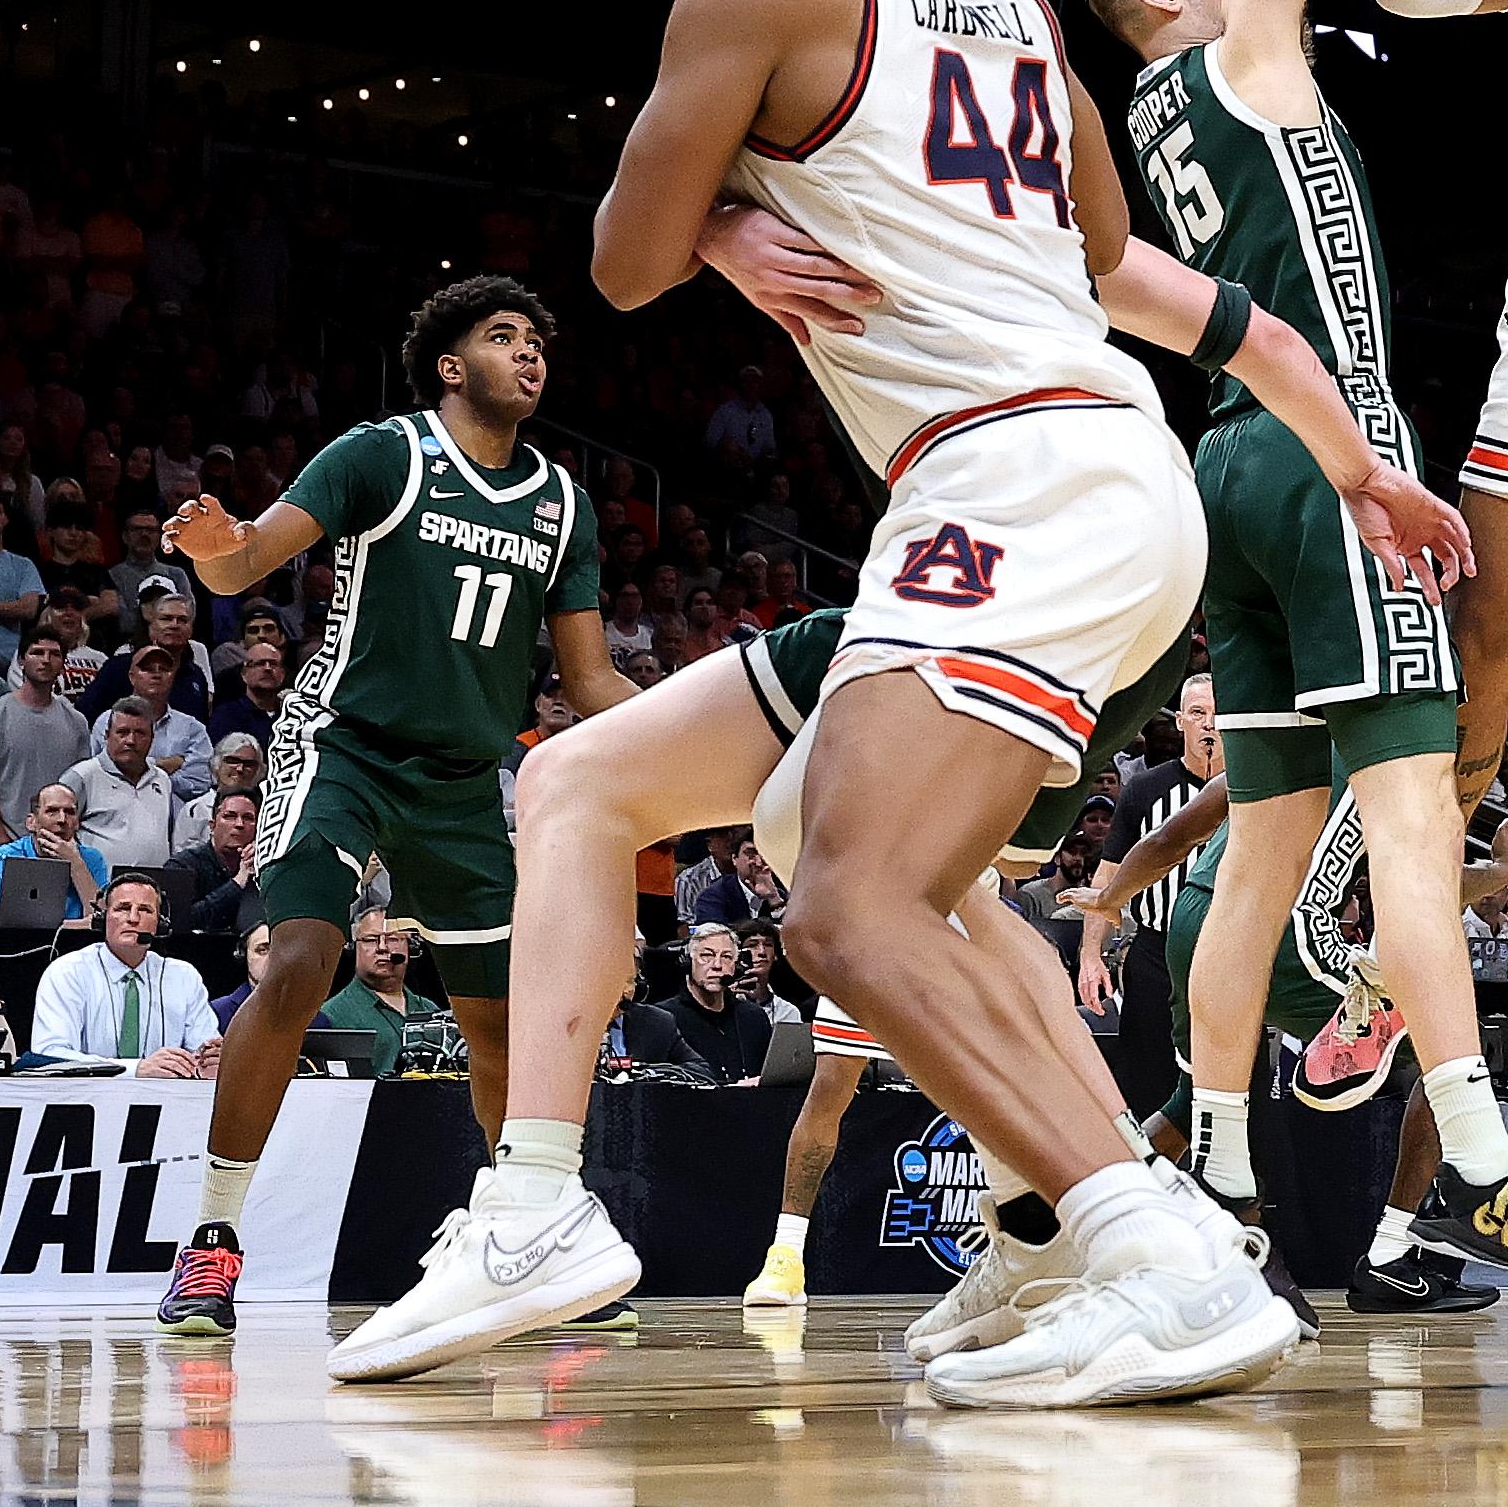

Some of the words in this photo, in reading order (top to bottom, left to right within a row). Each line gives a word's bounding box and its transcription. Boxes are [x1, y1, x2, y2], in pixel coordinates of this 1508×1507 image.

[922, 47, 1076, 231] 44
[1128, 70, 1191, 151] COOPER
[1147, 119, 1225, 261] 15
[430, 459, 449, 475] JF
[418, 511, 552, 573] SPARTANS
[450, 564, 513, 648] 11
[928, 1151, 990, 1186] MAR
[494, 1245, 544, 1281] PSYCHO
